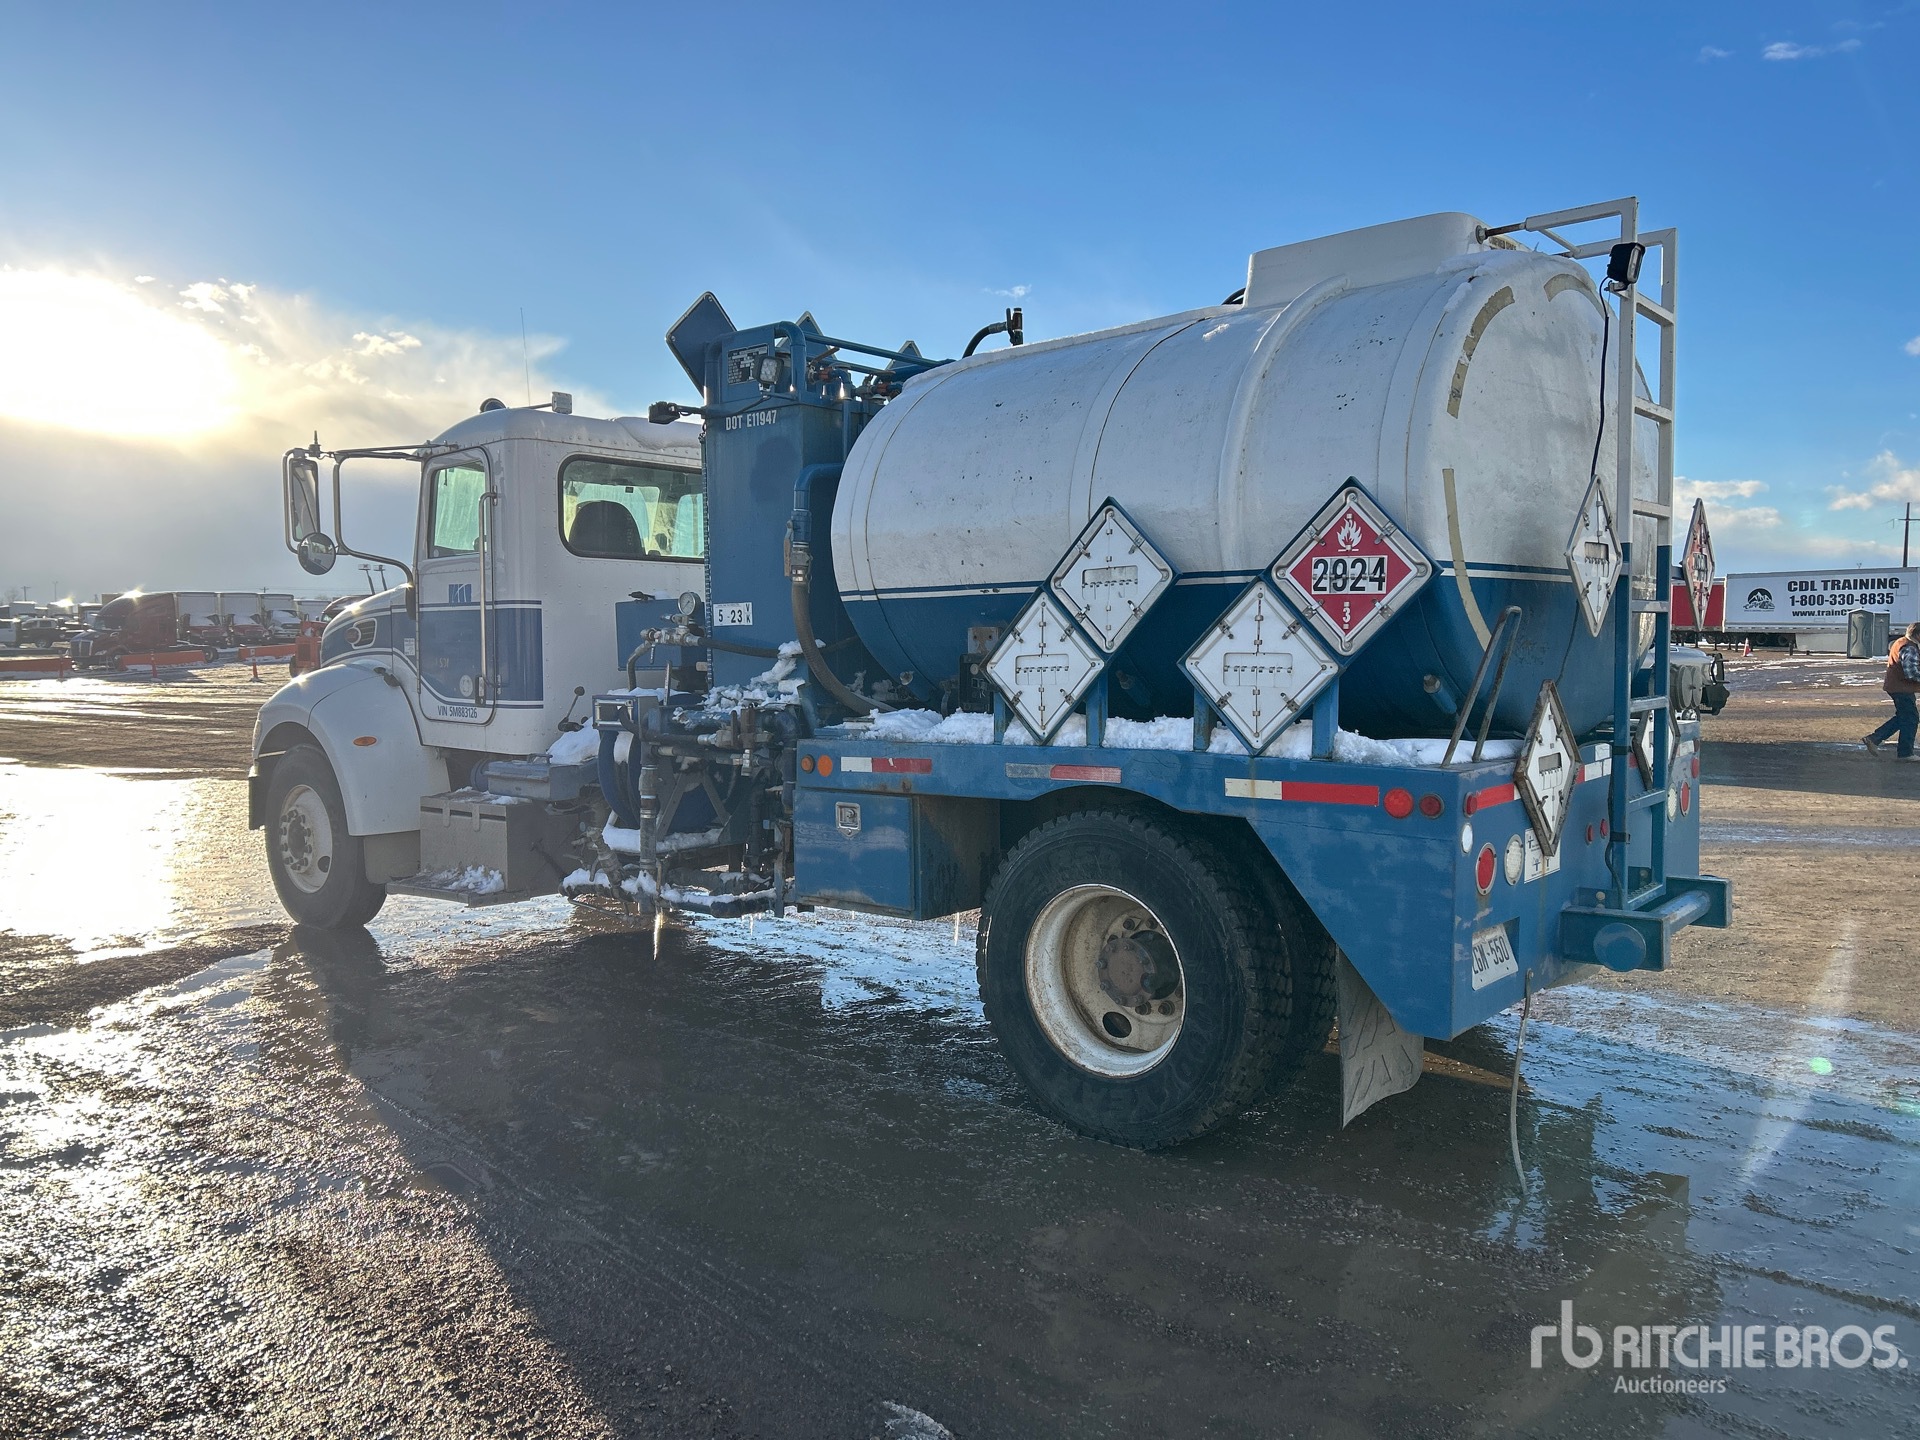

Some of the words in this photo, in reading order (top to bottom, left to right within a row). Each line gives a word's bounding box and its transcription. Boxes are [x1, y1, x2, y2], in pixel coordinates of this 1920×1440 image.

[725, 415, 743, 431] DOT
[746, 410, 777, 428] E11947
[1312, 557, 1386, 592] 2924
[1787, 580, 1818, 592] CDL
[1820, 577, 1900, 592] TRAINING
[1789, 592, 1895, 607] 1-800-330-8835
[1342, 607, 1351, 623] 3
[1792, 608, 1853, 617] www.trainC
[437, 705, 448, 716] VIN
